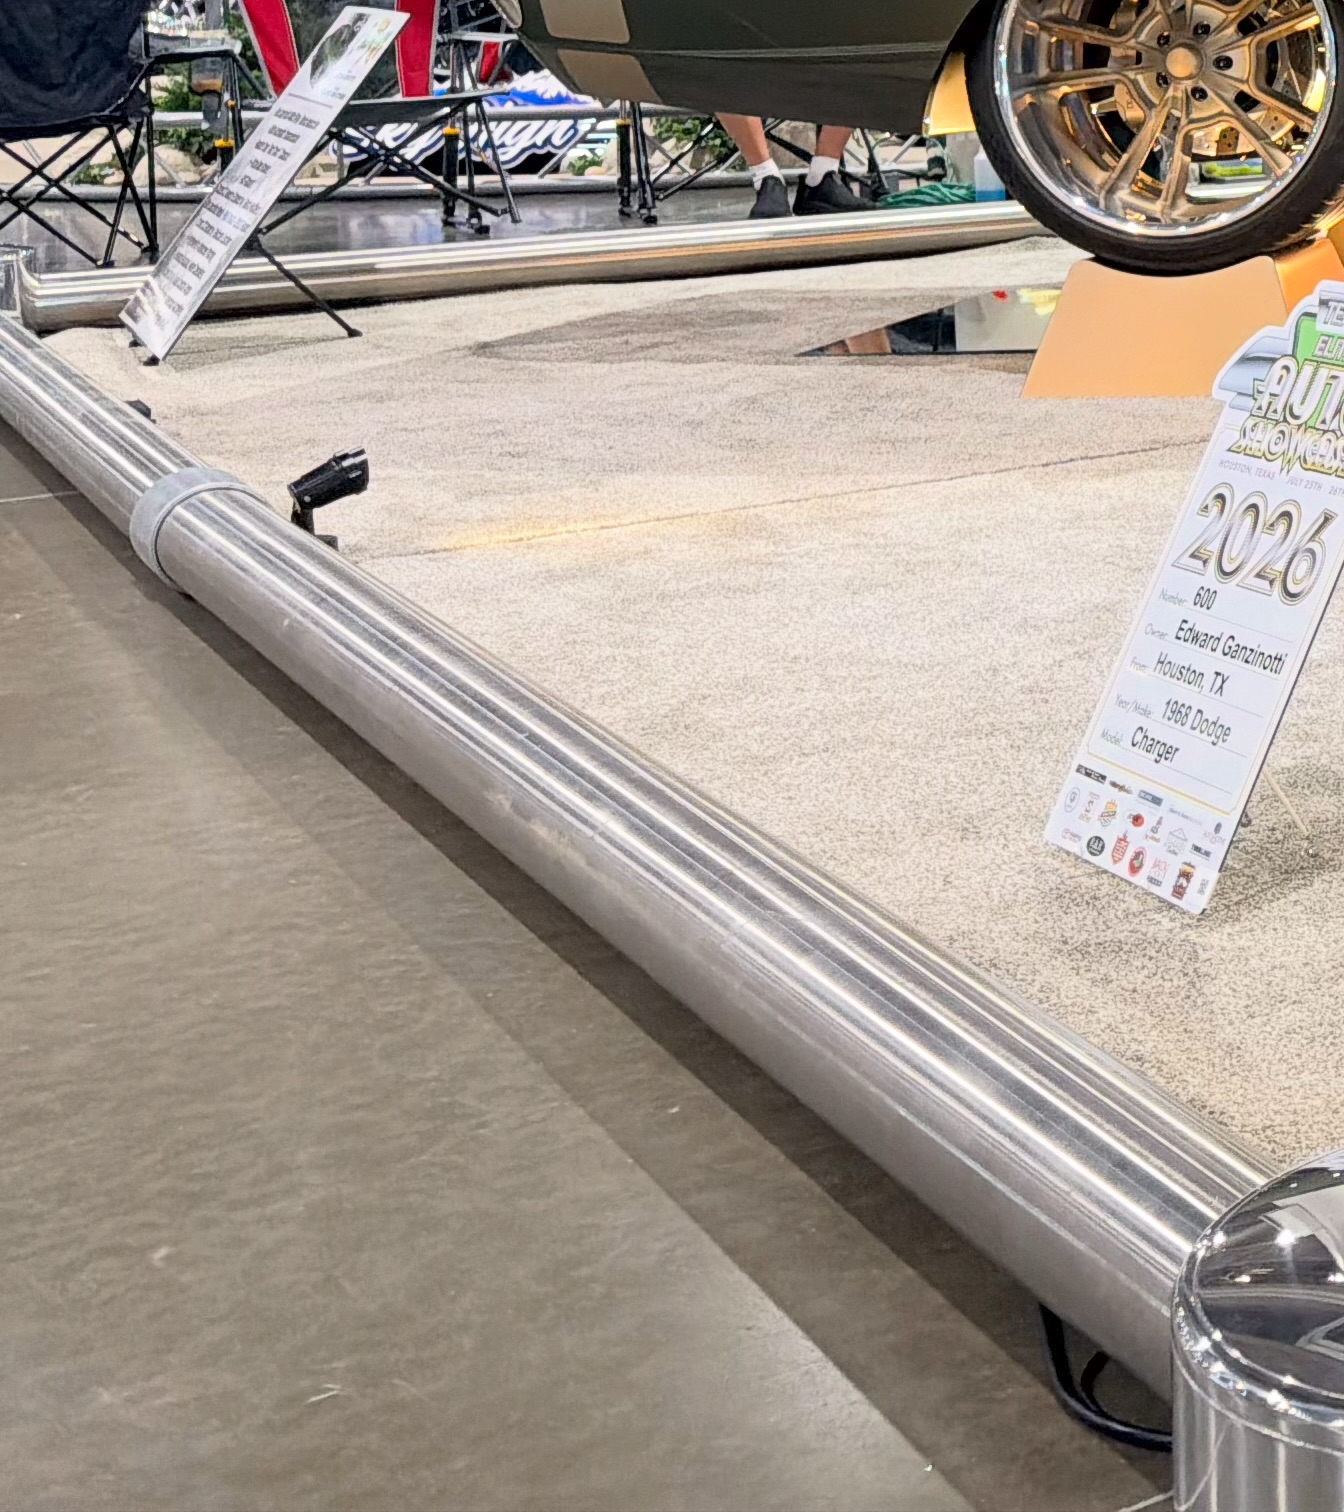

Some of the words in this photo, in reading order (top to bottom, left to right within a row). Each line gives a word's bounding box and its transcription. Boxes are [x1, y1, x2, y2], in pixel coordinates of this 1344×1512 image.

[1254, 468, 1277, 481] TEXAS
[1171, 481, 1339, 607] 2026
[1193, 586, 1218, 610] 600
[1174, 619, 1224, 653] Edward
[1221, 635, 1288, 675] Ganzinotti
[1153, 651, 1205, 691] Houston,
[1209, 670, 1231, 697] TX
[1162, 697, 1193, 727] 1968
[1190, 709, 1232, 746] Dodge
[1131, 726, 1181, 764] Charger
